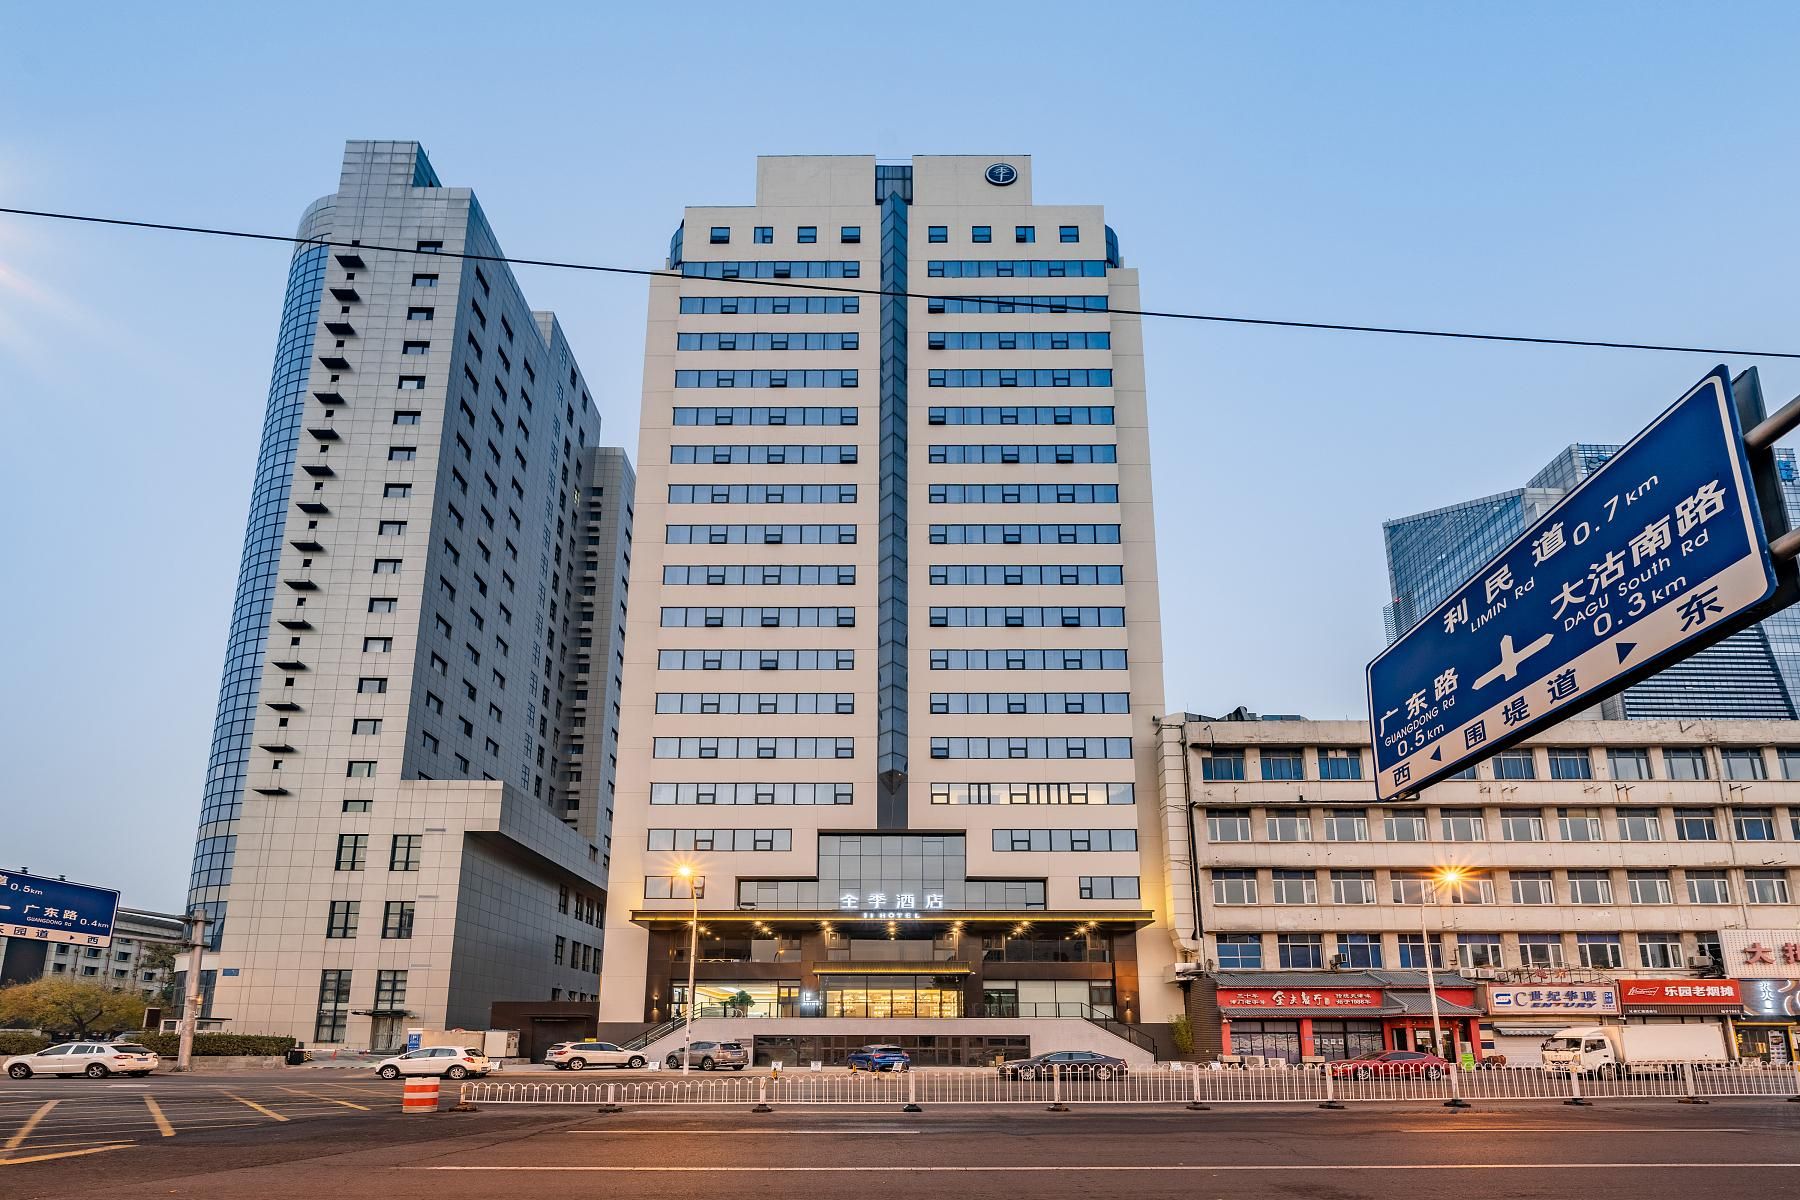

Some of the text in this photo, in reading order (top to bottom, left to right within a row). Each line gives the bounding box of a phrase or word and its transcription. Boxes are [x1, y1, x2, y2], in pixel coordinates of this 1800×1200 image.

[1550, 479, 1726, 621] 大沽南路
[1443, 520, 1567, 634] 利民道
[1564, 528, 1709, 632] DAGU South Rd
[1470, 576, 1535, 633] LIMIN Rd
[1380, 667, 1459, 738] 广东路
[1392, 584, 1726, 788] 西 围堤道 东
[1384, 695, 1455, 747] GUANGDONG Rd
[23, 904, 78, 921] 广东路
[26, 916, 62, 926] GUANGDONG
[840, 893, 944, 909] 全季酒店
[87, 936, 99, 944] 西
[1528, 990, 1597, 1002] 世纪华联
[1664, 985, 1735, 997] 乐园老烟摊
